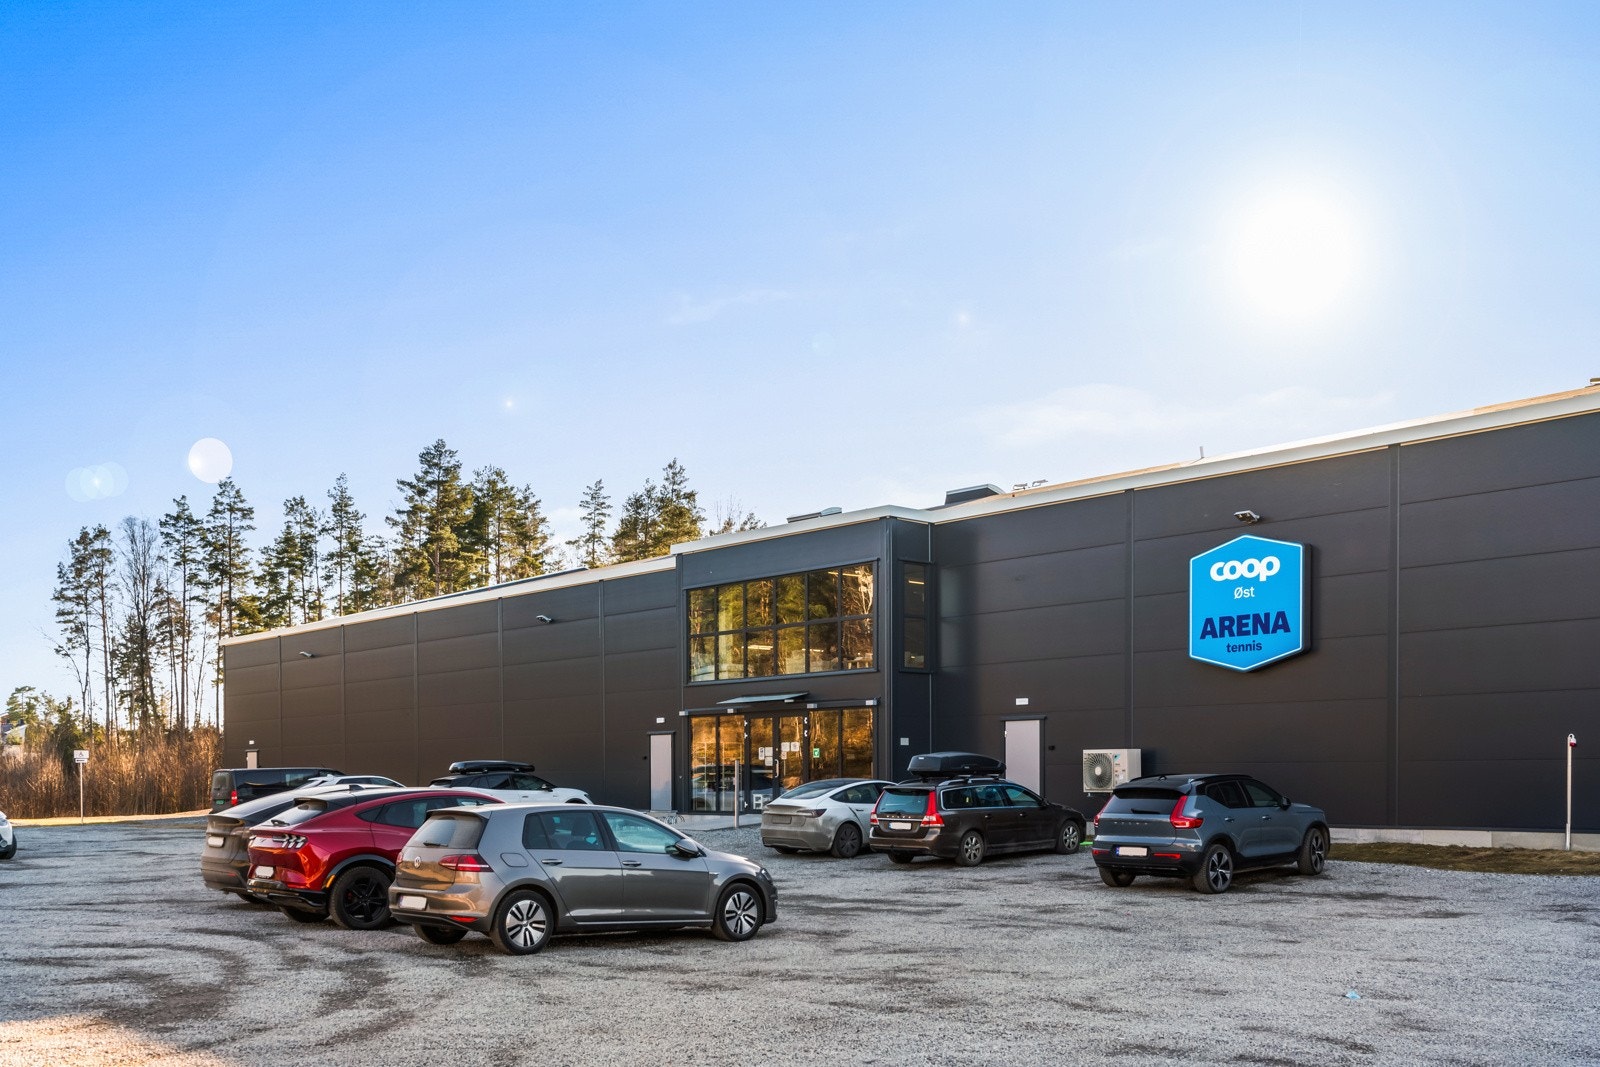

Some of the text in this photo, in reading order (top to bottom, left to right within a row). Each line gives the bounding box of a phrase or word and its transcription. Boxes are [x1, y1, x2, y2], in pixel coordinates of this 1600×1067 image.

[1210, 556, 1280, 582] coop
[1234, 586, 1255, 599] Øst
[1200, 610, 1291, 640] ARENA
[1226, 640, 1262, 652] tennis
